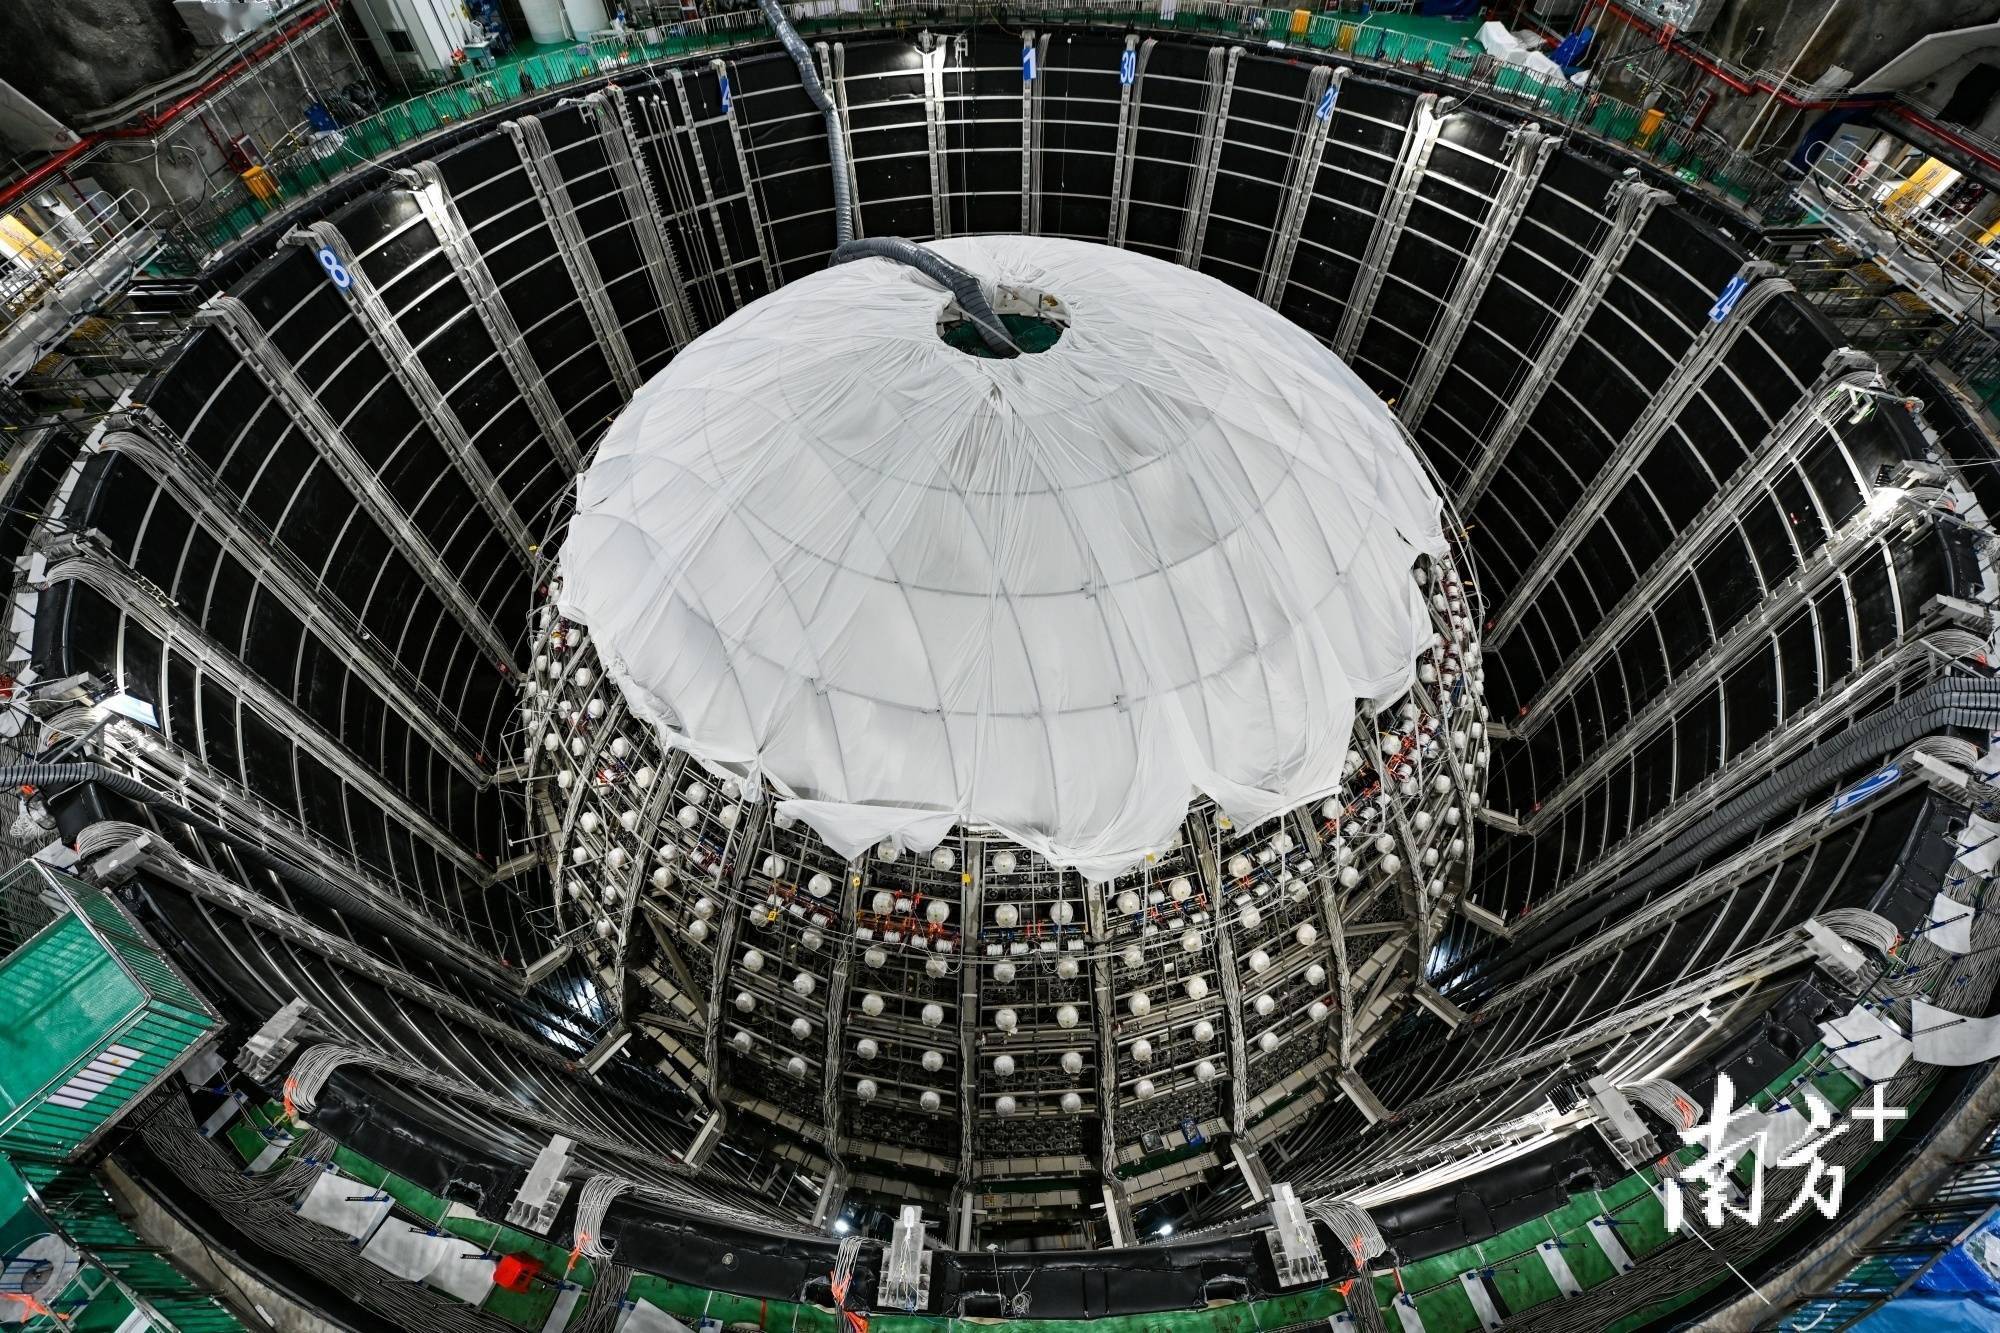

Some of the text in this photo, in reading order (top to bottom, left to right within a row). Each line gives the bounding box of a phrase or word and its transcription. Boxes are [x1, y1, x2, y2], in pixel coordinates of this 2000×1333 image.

[1023, 47, 1036, 79] 1
[1121, 51, 1136, 83] 30
[319, 249, 350, 288] 8
[1708, 277, 1747, 320] 24
